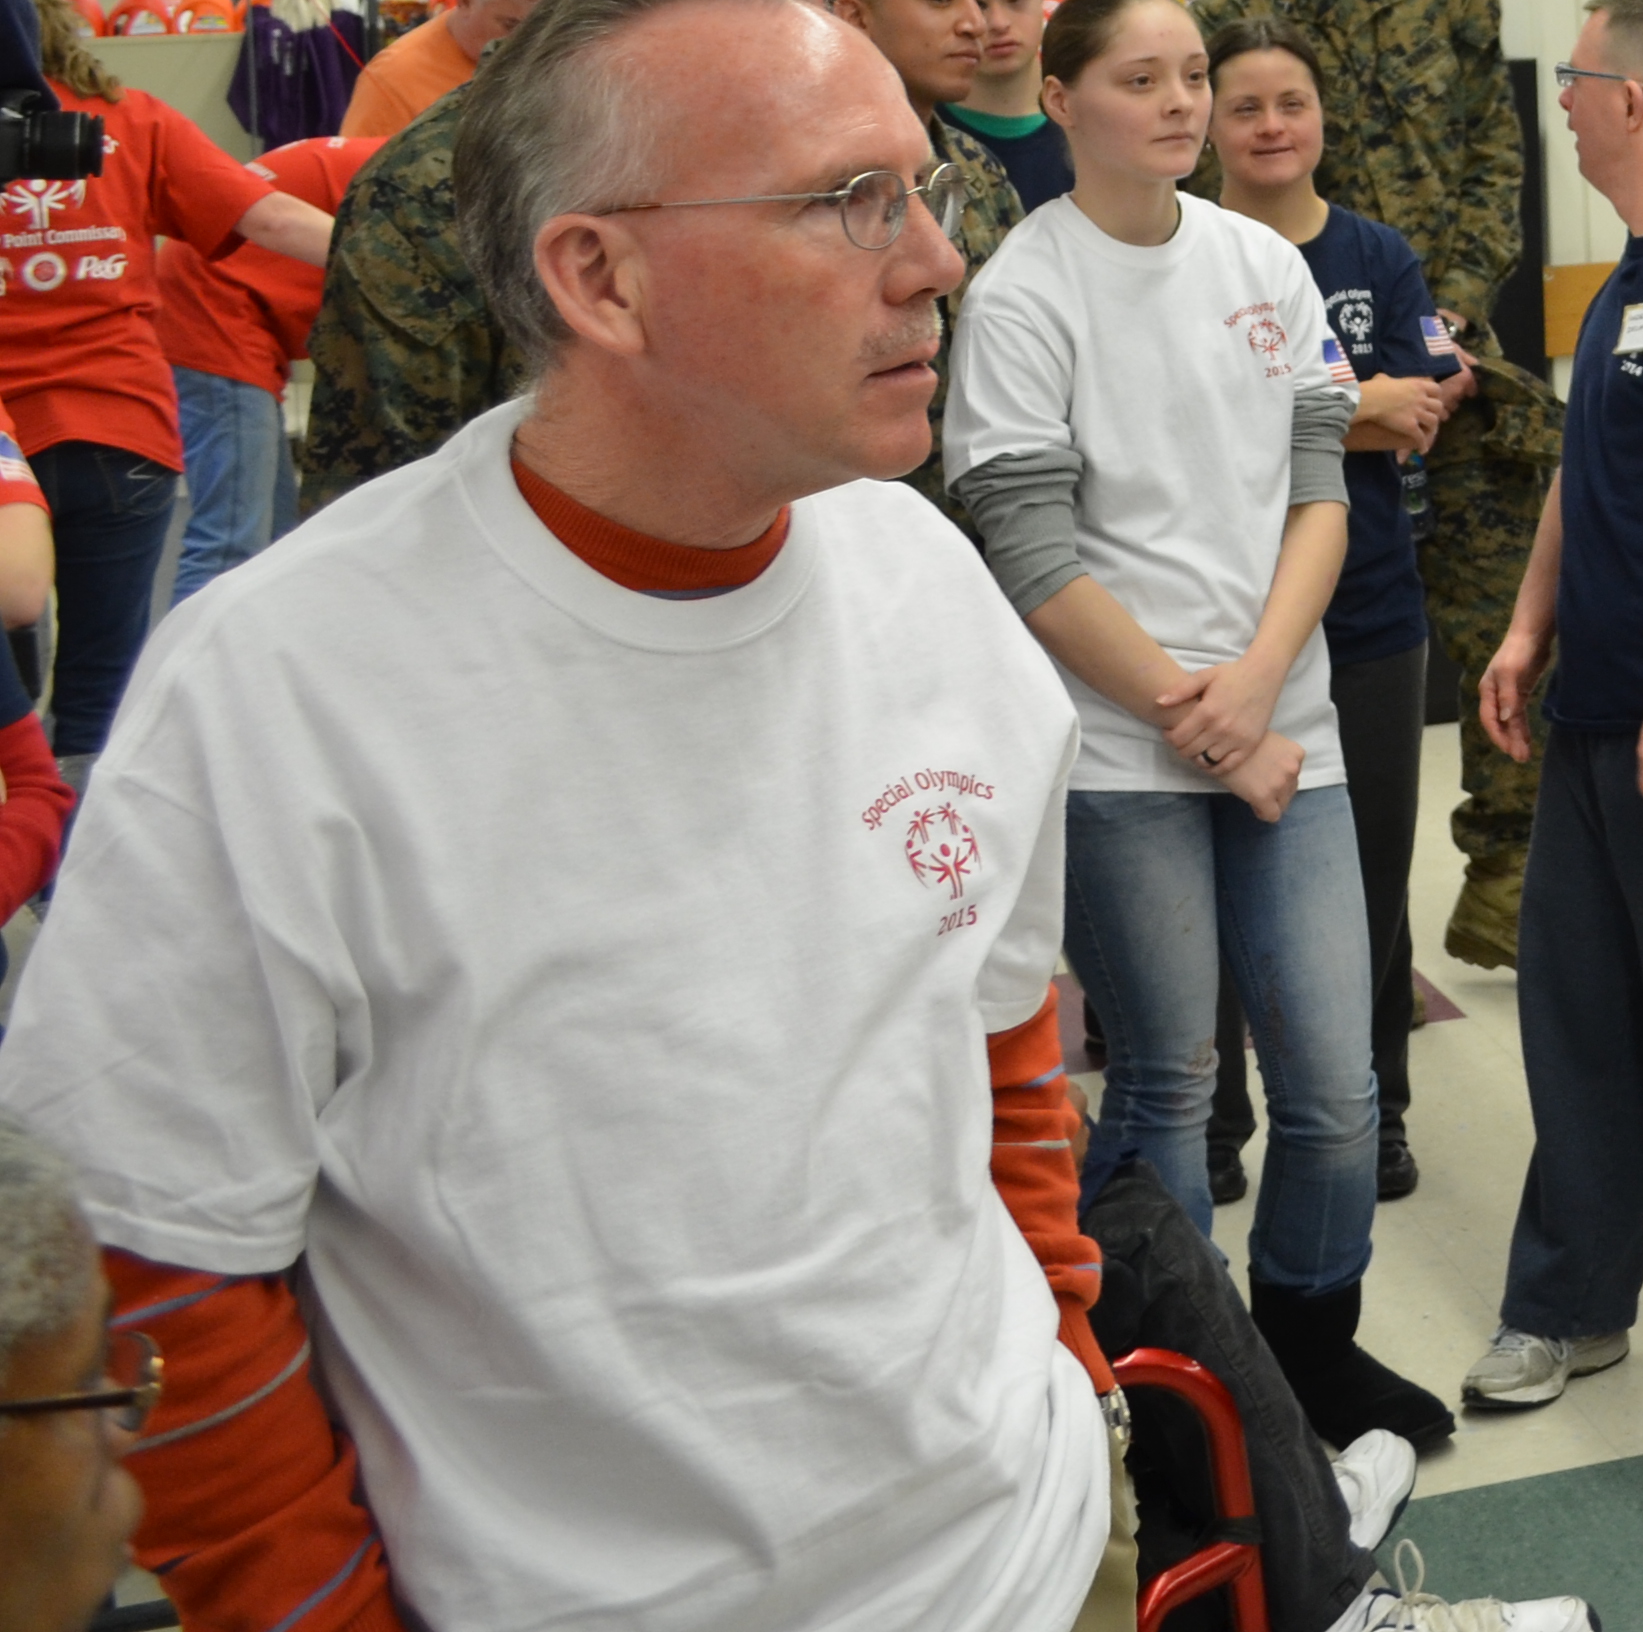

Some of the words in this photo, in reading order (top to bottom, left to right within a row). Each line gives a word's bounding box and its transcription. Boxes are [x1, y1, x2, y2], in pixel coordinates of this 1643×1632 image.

[4, 231, 43, 248] Point
[75, 253, 128, 280] P&G
[1325, 290, 1348, 310] pecial
[1352, 343, 1373, 355] 2015
[1265, 363, 1292, 378] 2015
[861, 776, 914, 831] Special
[914, 768, 995, 800] Olympics
[938, 904, 977, 936] 2015
